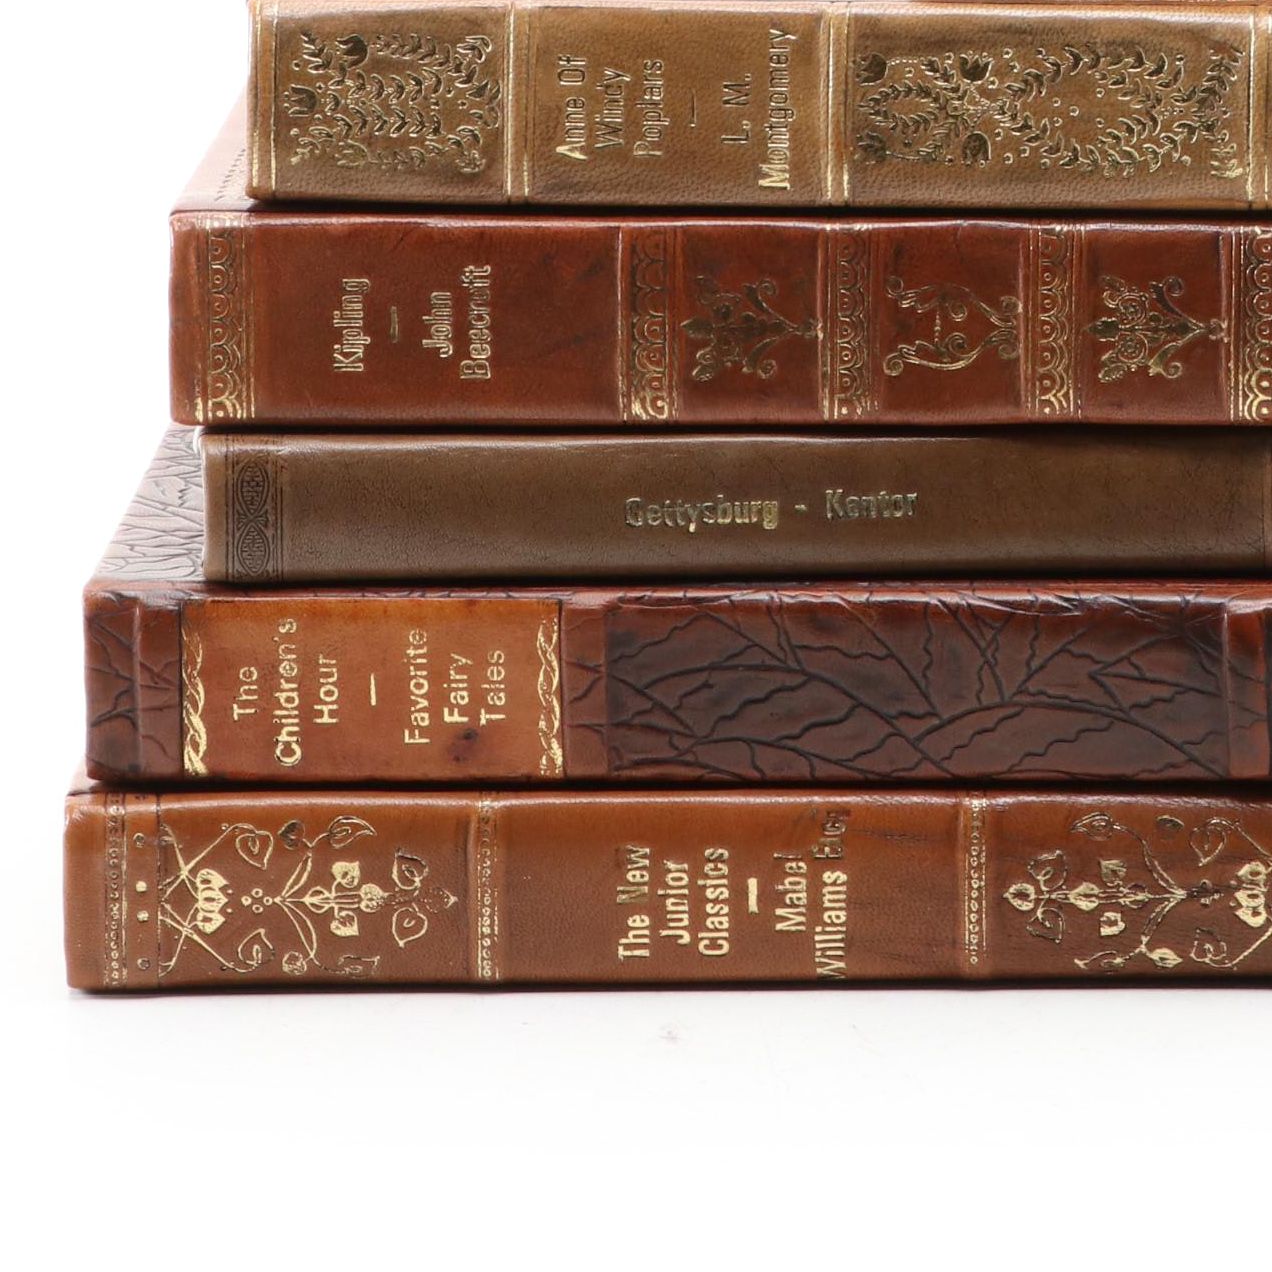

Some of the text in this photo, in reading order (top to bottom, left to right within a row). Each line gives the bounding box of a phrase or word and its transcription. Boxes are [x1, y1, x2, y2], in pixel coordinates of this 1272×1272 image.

[556, 53, 588, 160] Anne Of
[594, 66, 631, 149] Windy
[633, 59, 671, 158] Poplars
[720, 73, 752, 145] L. M.
[758, 28, 798, 191] Montgomery
[333, 278, 371, 372] Kipling
[422, 291, 453, 358] John
[460, 264, 492, 379] Beecroft
[625, 494, 778, 533] Gettysburg
[825, 488, 918, 520] Kantor
[233, 666, 258, 722] The
[273, 617, 302, 766] Children's
[313, 653, 339, 724] Hour
[403, 628, 431, 745] Favorite
[443, 652, 473, 725] Fairy
[479, 649, 506, 726] Tales
[616, 844, 651, 962] The New
[657, 859, 691, 945] Junior
[697, 847, 730, 957] Classics
[773, 852, 808, 932] Mabel
[814, 870, 848, 978] Williams
